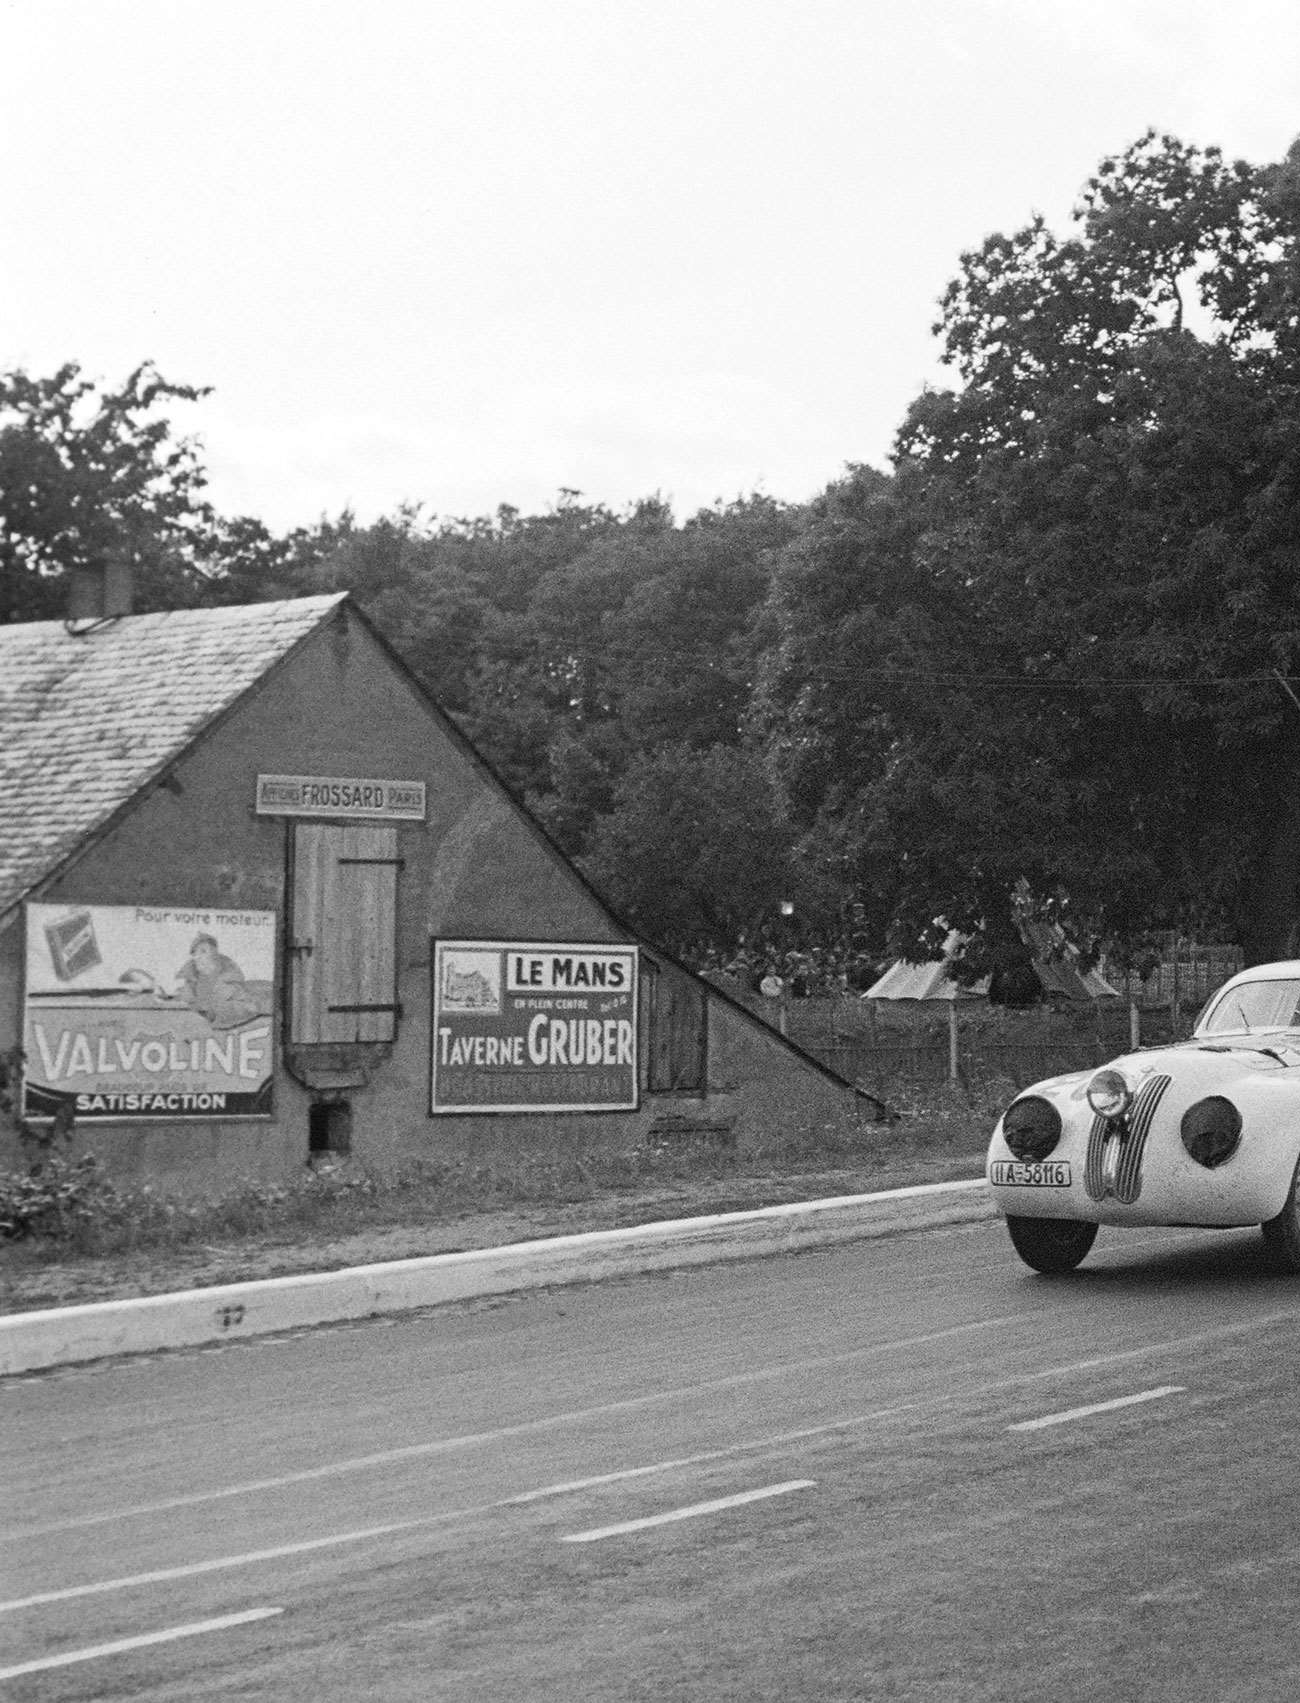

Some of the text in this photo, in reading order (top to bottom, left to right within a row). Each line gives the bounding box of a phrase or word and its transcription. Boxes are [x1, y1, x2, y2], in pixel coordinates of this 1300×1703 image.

[301, 784, 384, 808] FROSSARD
[135, 907, 171, 923] Pour
[515, 957, 624, 987] LE MANS
[555, 999, 588, 1010] CENTRE
[439, 1014, 632, 1065] TAVERNE GRUBER
[34, 1023, 271, 1082] VALVOLINE
[75, 1093, 227, 1111] SATISFACTION
